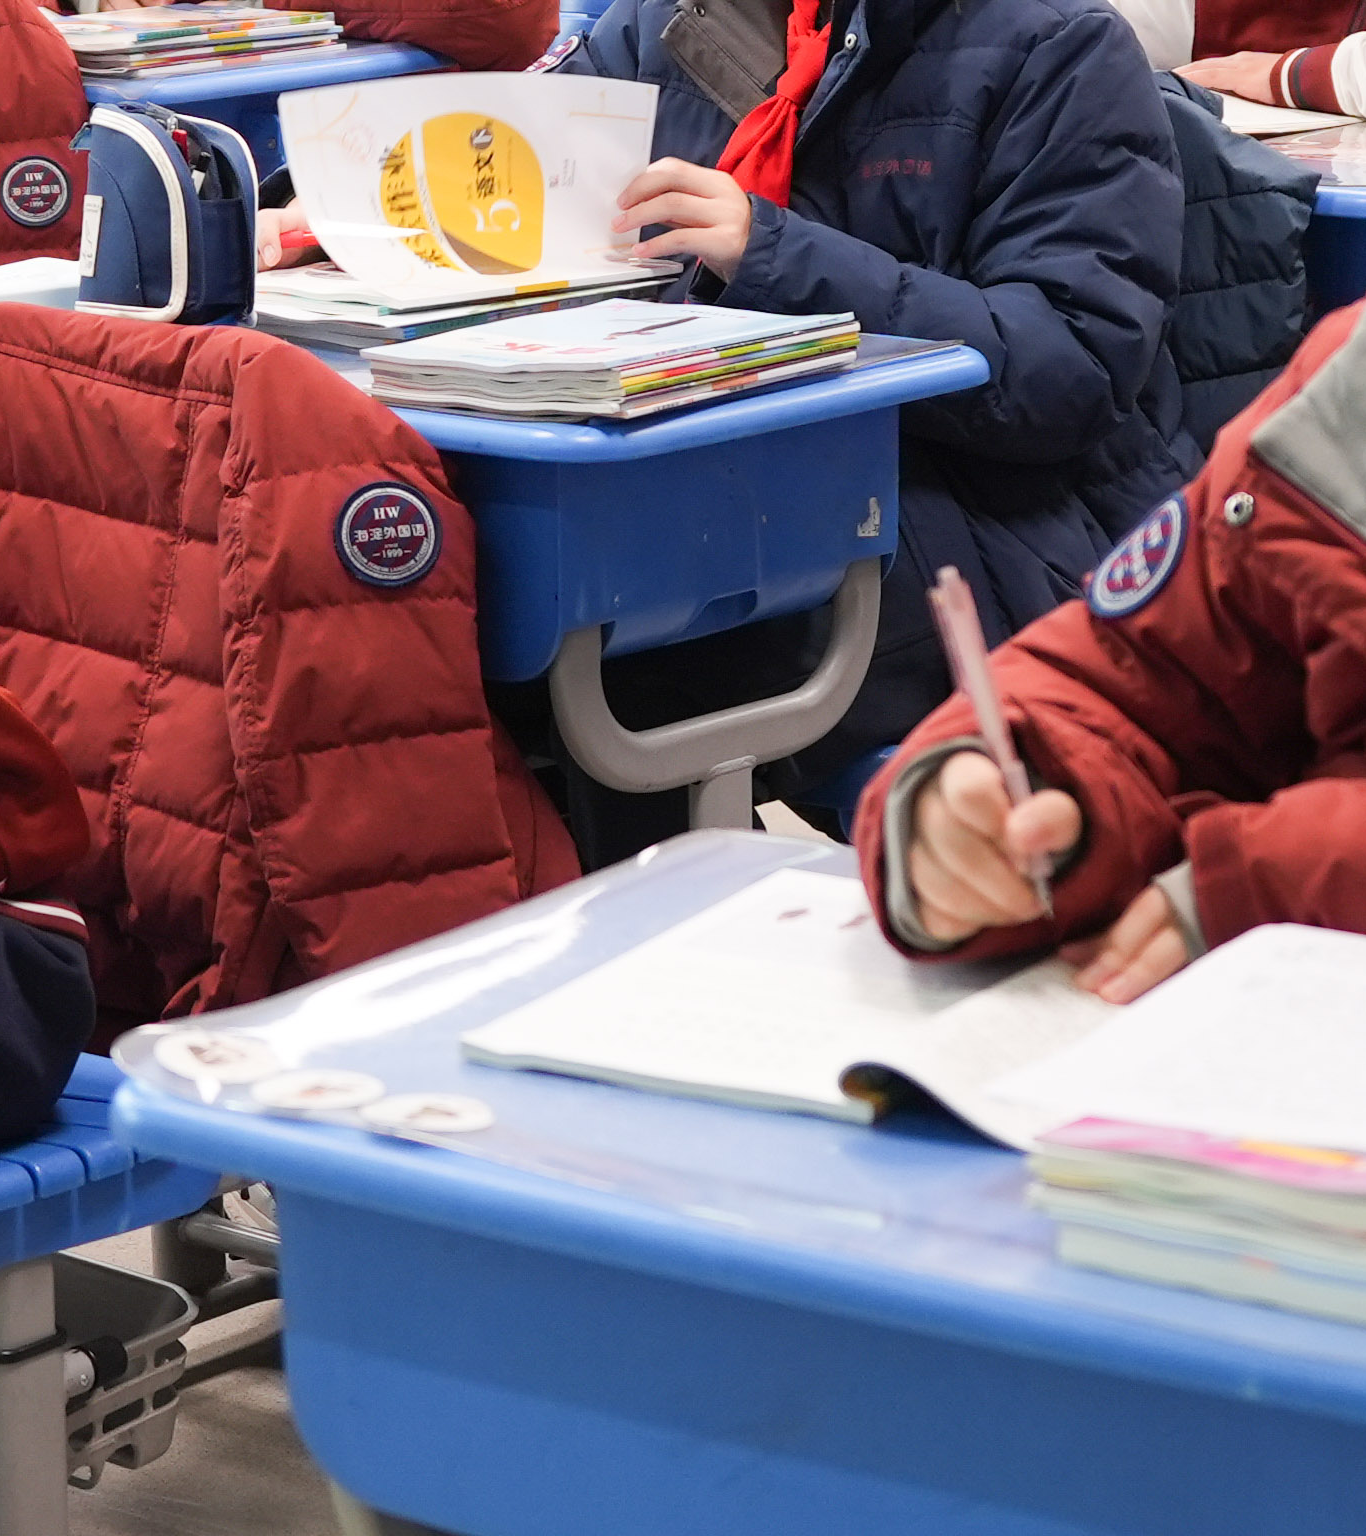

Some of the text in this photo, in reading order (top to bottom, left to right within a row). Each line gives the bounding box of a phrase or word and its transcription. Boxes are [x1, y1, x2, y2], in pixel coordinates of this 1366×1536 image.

[373, 506, 400, 520] HW
[354, 523, 425, 543] 海淀外国语
